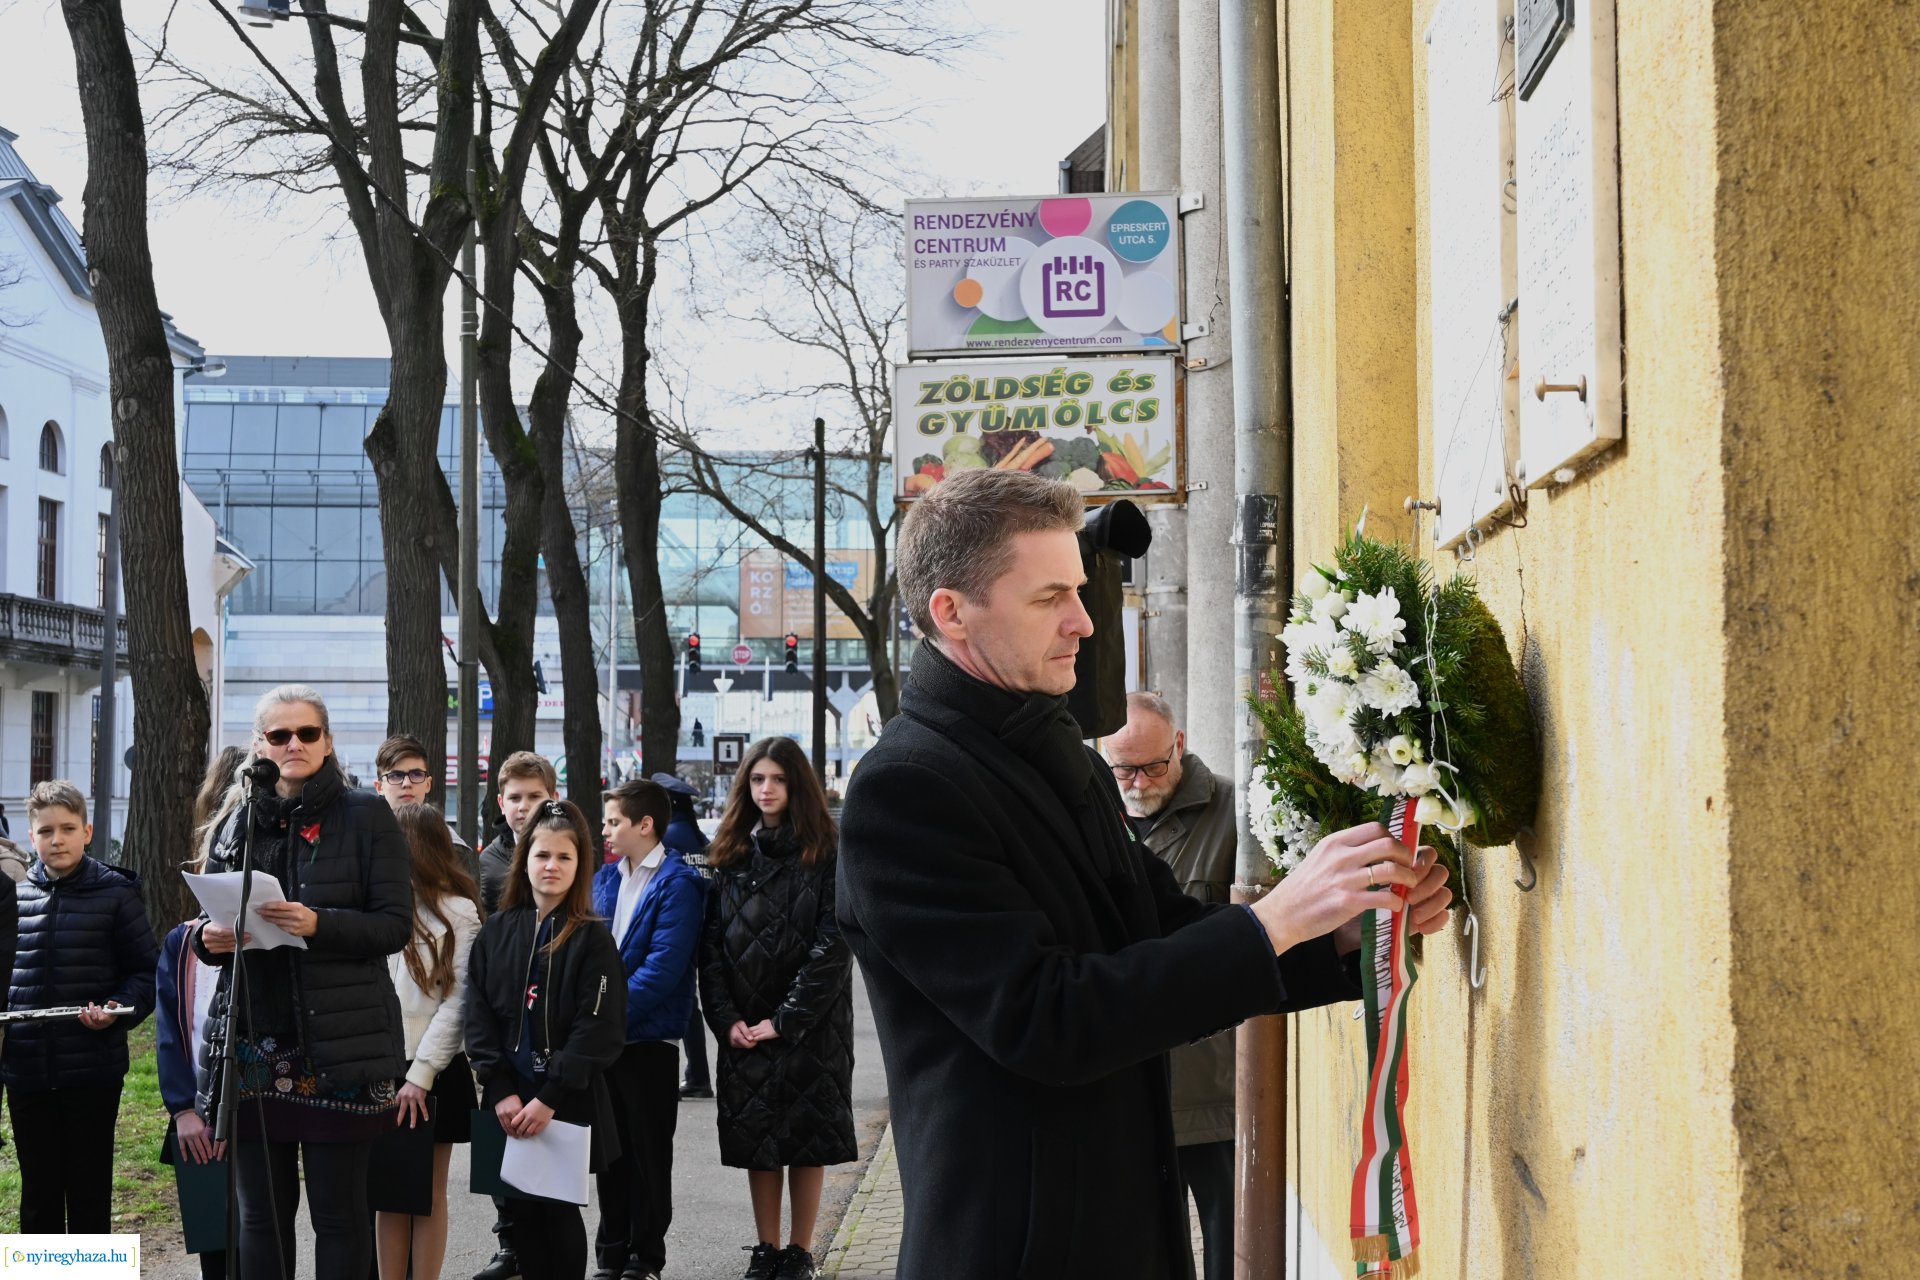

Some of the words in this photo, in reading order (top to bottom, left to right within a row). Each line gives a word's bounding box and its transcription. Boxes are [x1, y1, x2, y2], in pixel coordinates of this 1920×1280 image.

[914, 209, 1037, 230] RENDEZVÉNY
[1110, 222, 1168, 233] EPRESKERT
[914, 237, 1006, 254] CENTRUM
[1118, 235, 1146, 245] UTCA
[1148, 234, 1157, 244] 5.
[914, 257, 927, 269] ÉS
[929, 258, 961, 269] PARTY
[963, 256, 1022, 268] SZAKÜZLET
[1056, 280, 1092, 302] RC
[966, 335, 1122, 348] www.rendezvenycentrum.com
[915, 367, 1094, 406] ZÖLDSÉG
[1107, 367, 1156, 393] és
[917, 398, 1160, 436] GYÜMÖLCS
[734, 650, 750, 659] STOP
